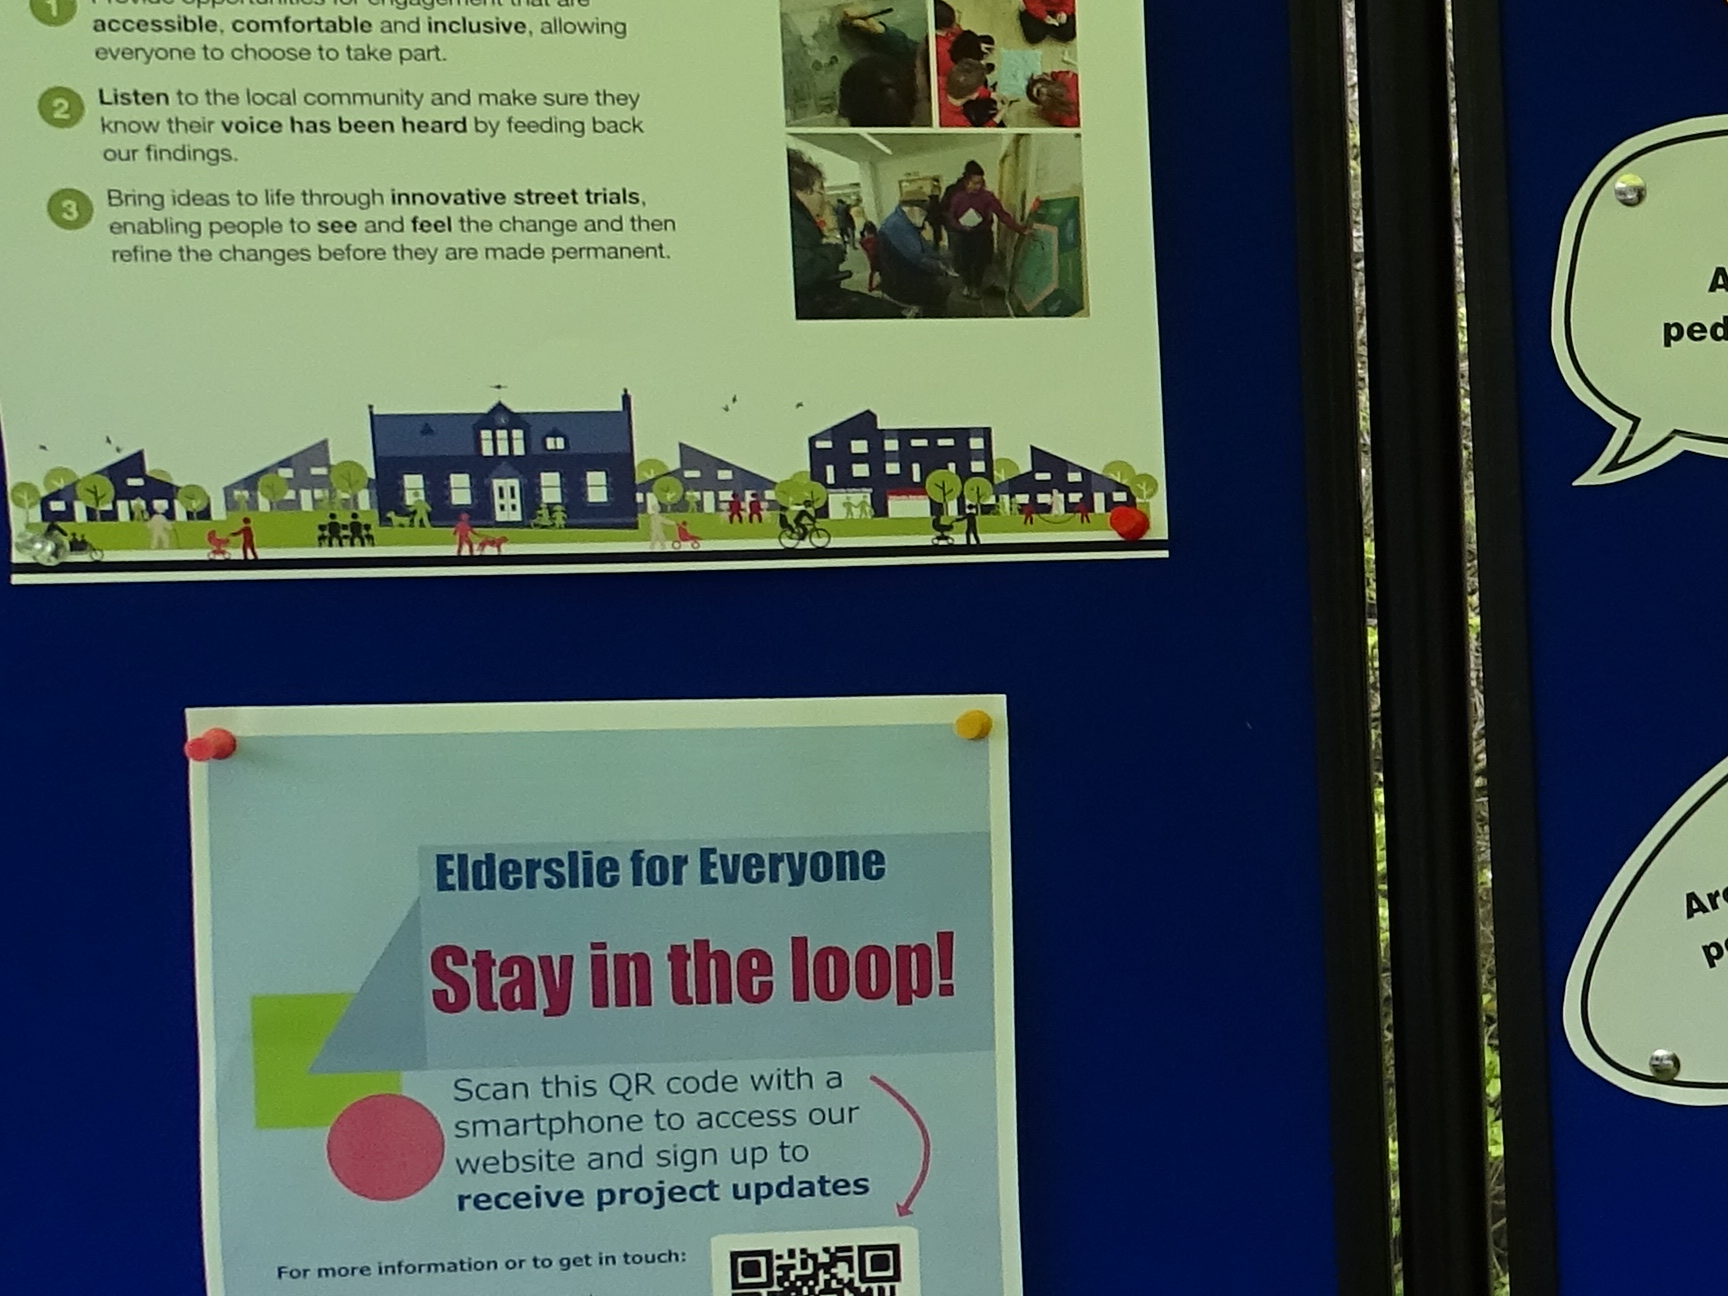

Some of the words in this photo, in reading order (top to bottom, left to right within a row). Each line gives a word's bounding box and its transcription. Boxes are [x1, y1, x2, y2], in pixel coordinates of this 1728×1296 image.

[102, 148, 140, 162] our
[145, 143, 238, 167] findings.
[435, 849, 621, 892] Elderslie
[629, 848, 689, 888] for
[699, 847, 886, 888] Everyone
[430, 944, 575, 1018] Stay
[589, 941, 653, 1009] in
[666, 938, 774, 1006] the
[790, 930, 955, 1007] loop!
[457, 1184, 585, 1212] receive
[596, 1179, 721, 1213] project
[732, 1174, 870, 1206] updates
